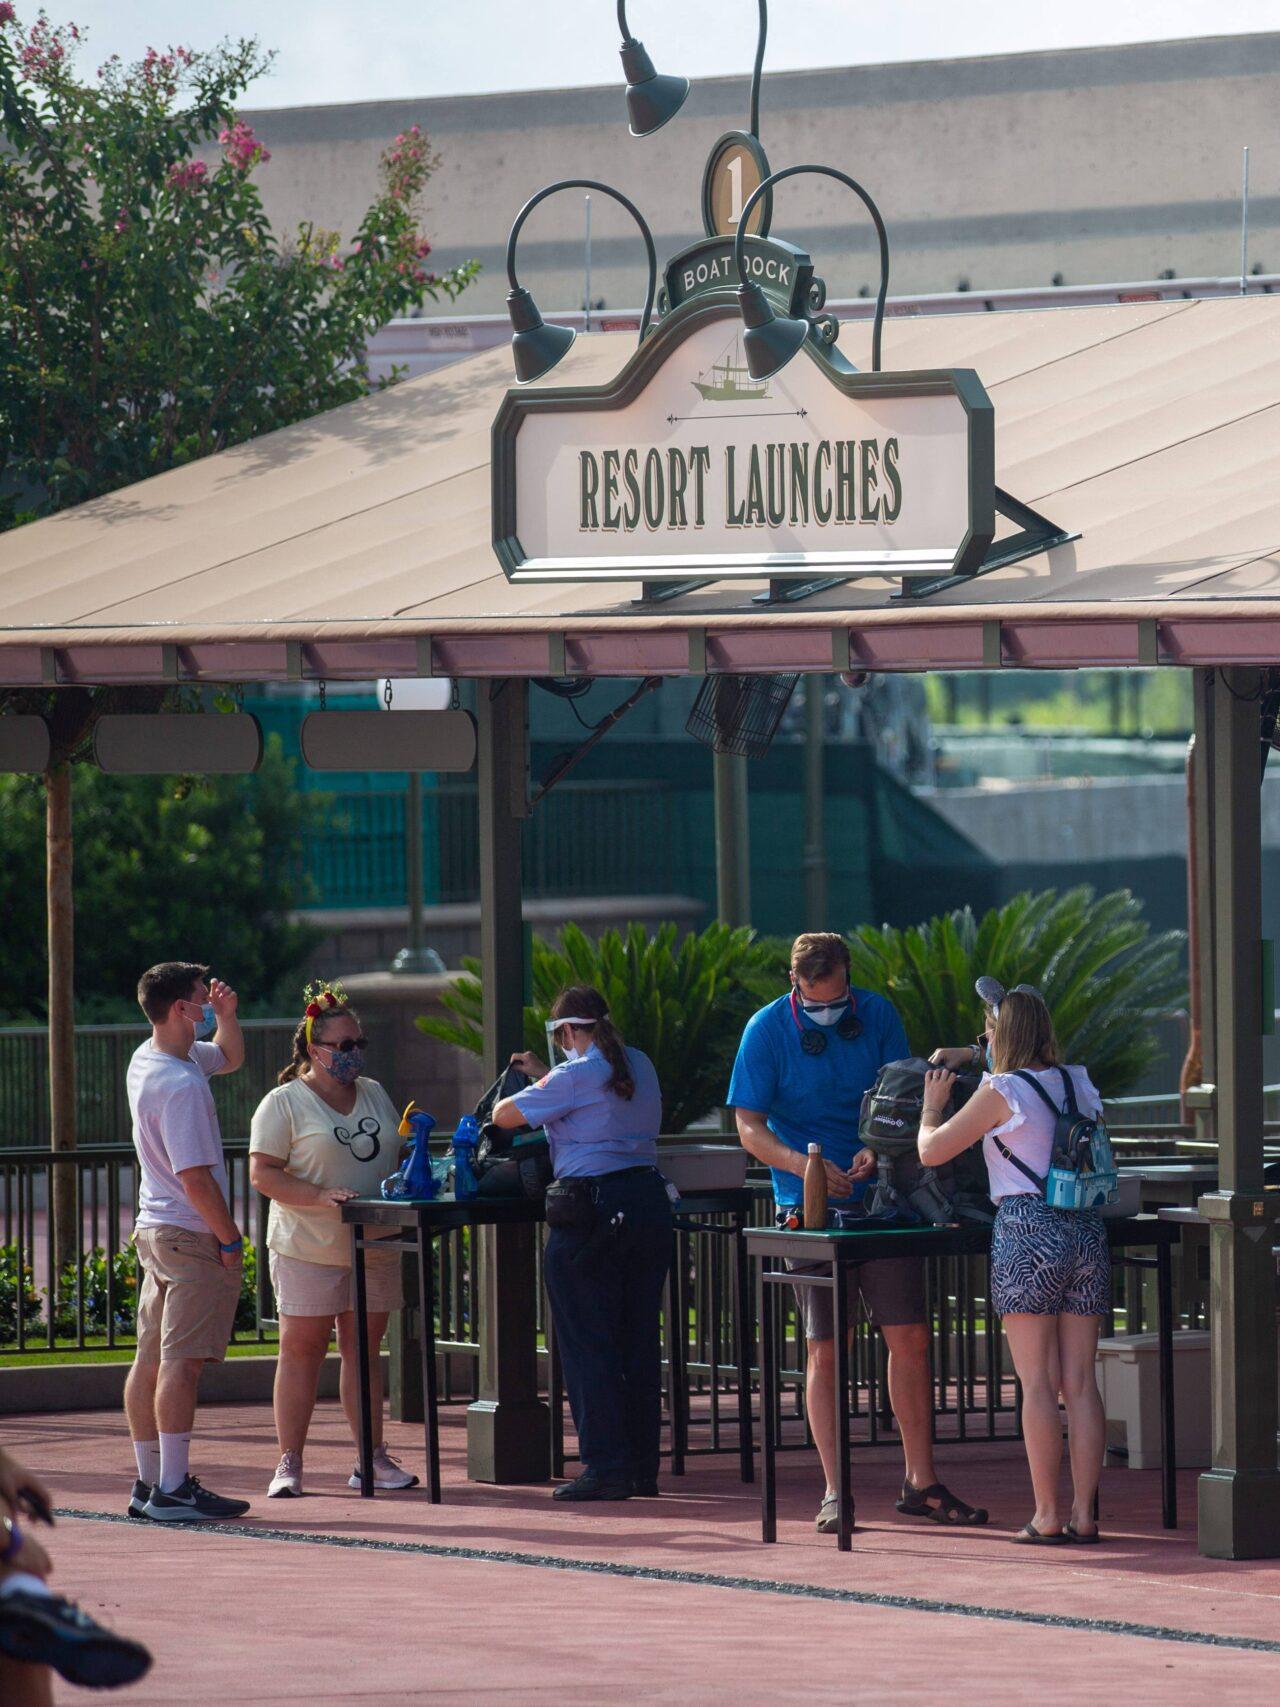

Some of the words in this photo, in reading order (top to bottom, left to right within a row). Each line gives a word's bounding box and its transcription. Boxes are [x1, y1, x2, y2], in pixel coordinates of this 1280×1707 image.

[727, 156, 743, 224] 1
[684, 256, 731, 291] BOAT
[579, 445, 711, 533] RESORT
[725, 437, 902, 529] LAUNCHES
